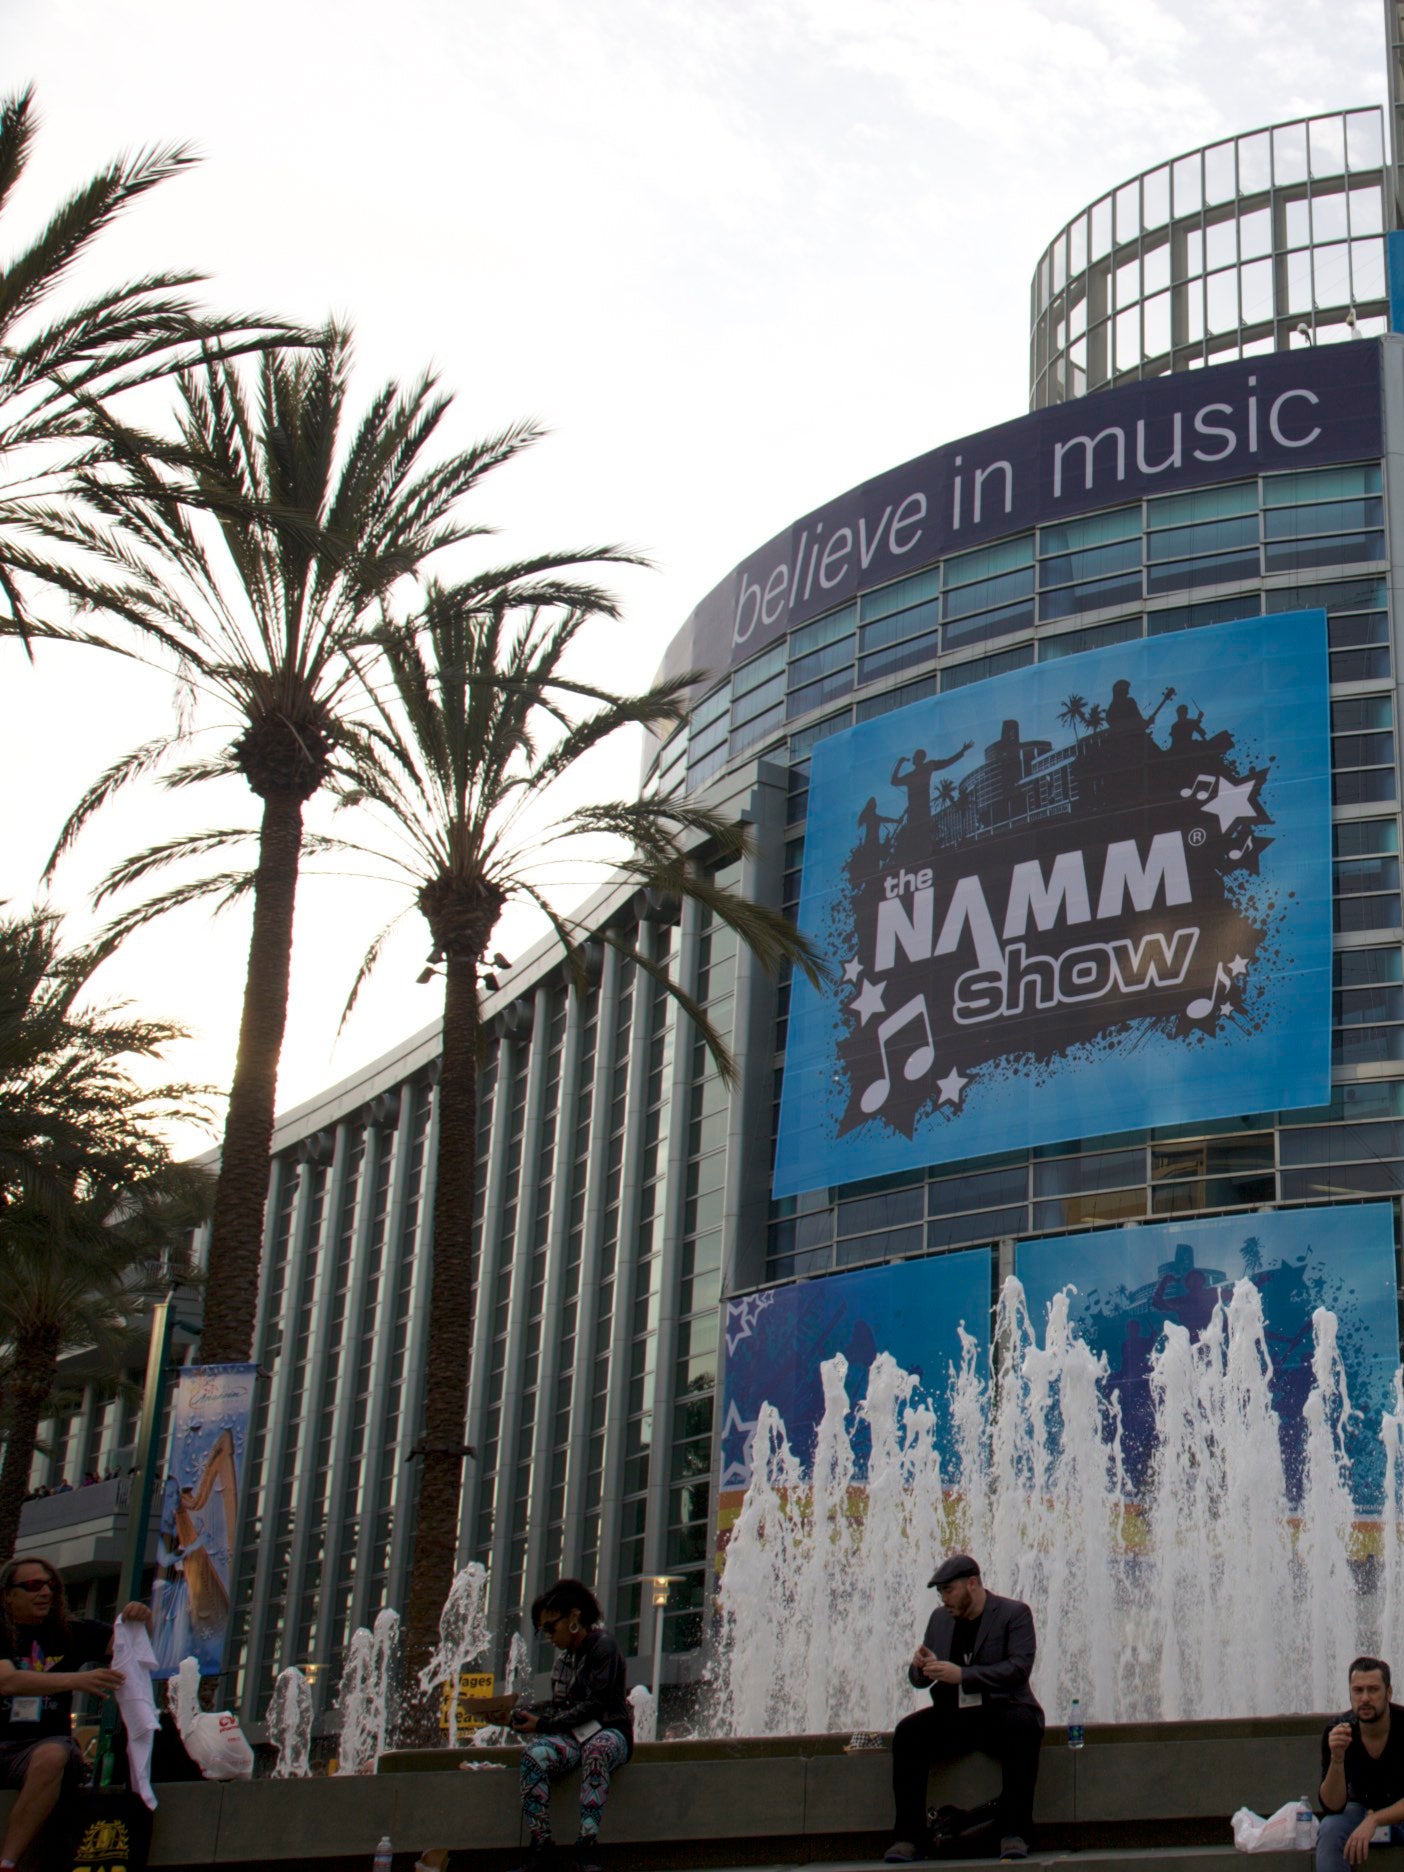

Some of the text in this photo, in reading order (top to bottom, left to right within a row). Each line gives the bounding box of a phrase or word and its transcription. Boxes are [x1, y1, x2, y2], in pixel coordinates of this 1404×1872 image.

[732, 376, 1322, 648] believe in music
[883, 867, 934, 897] the
[953, 927, 1201, 1025] show
